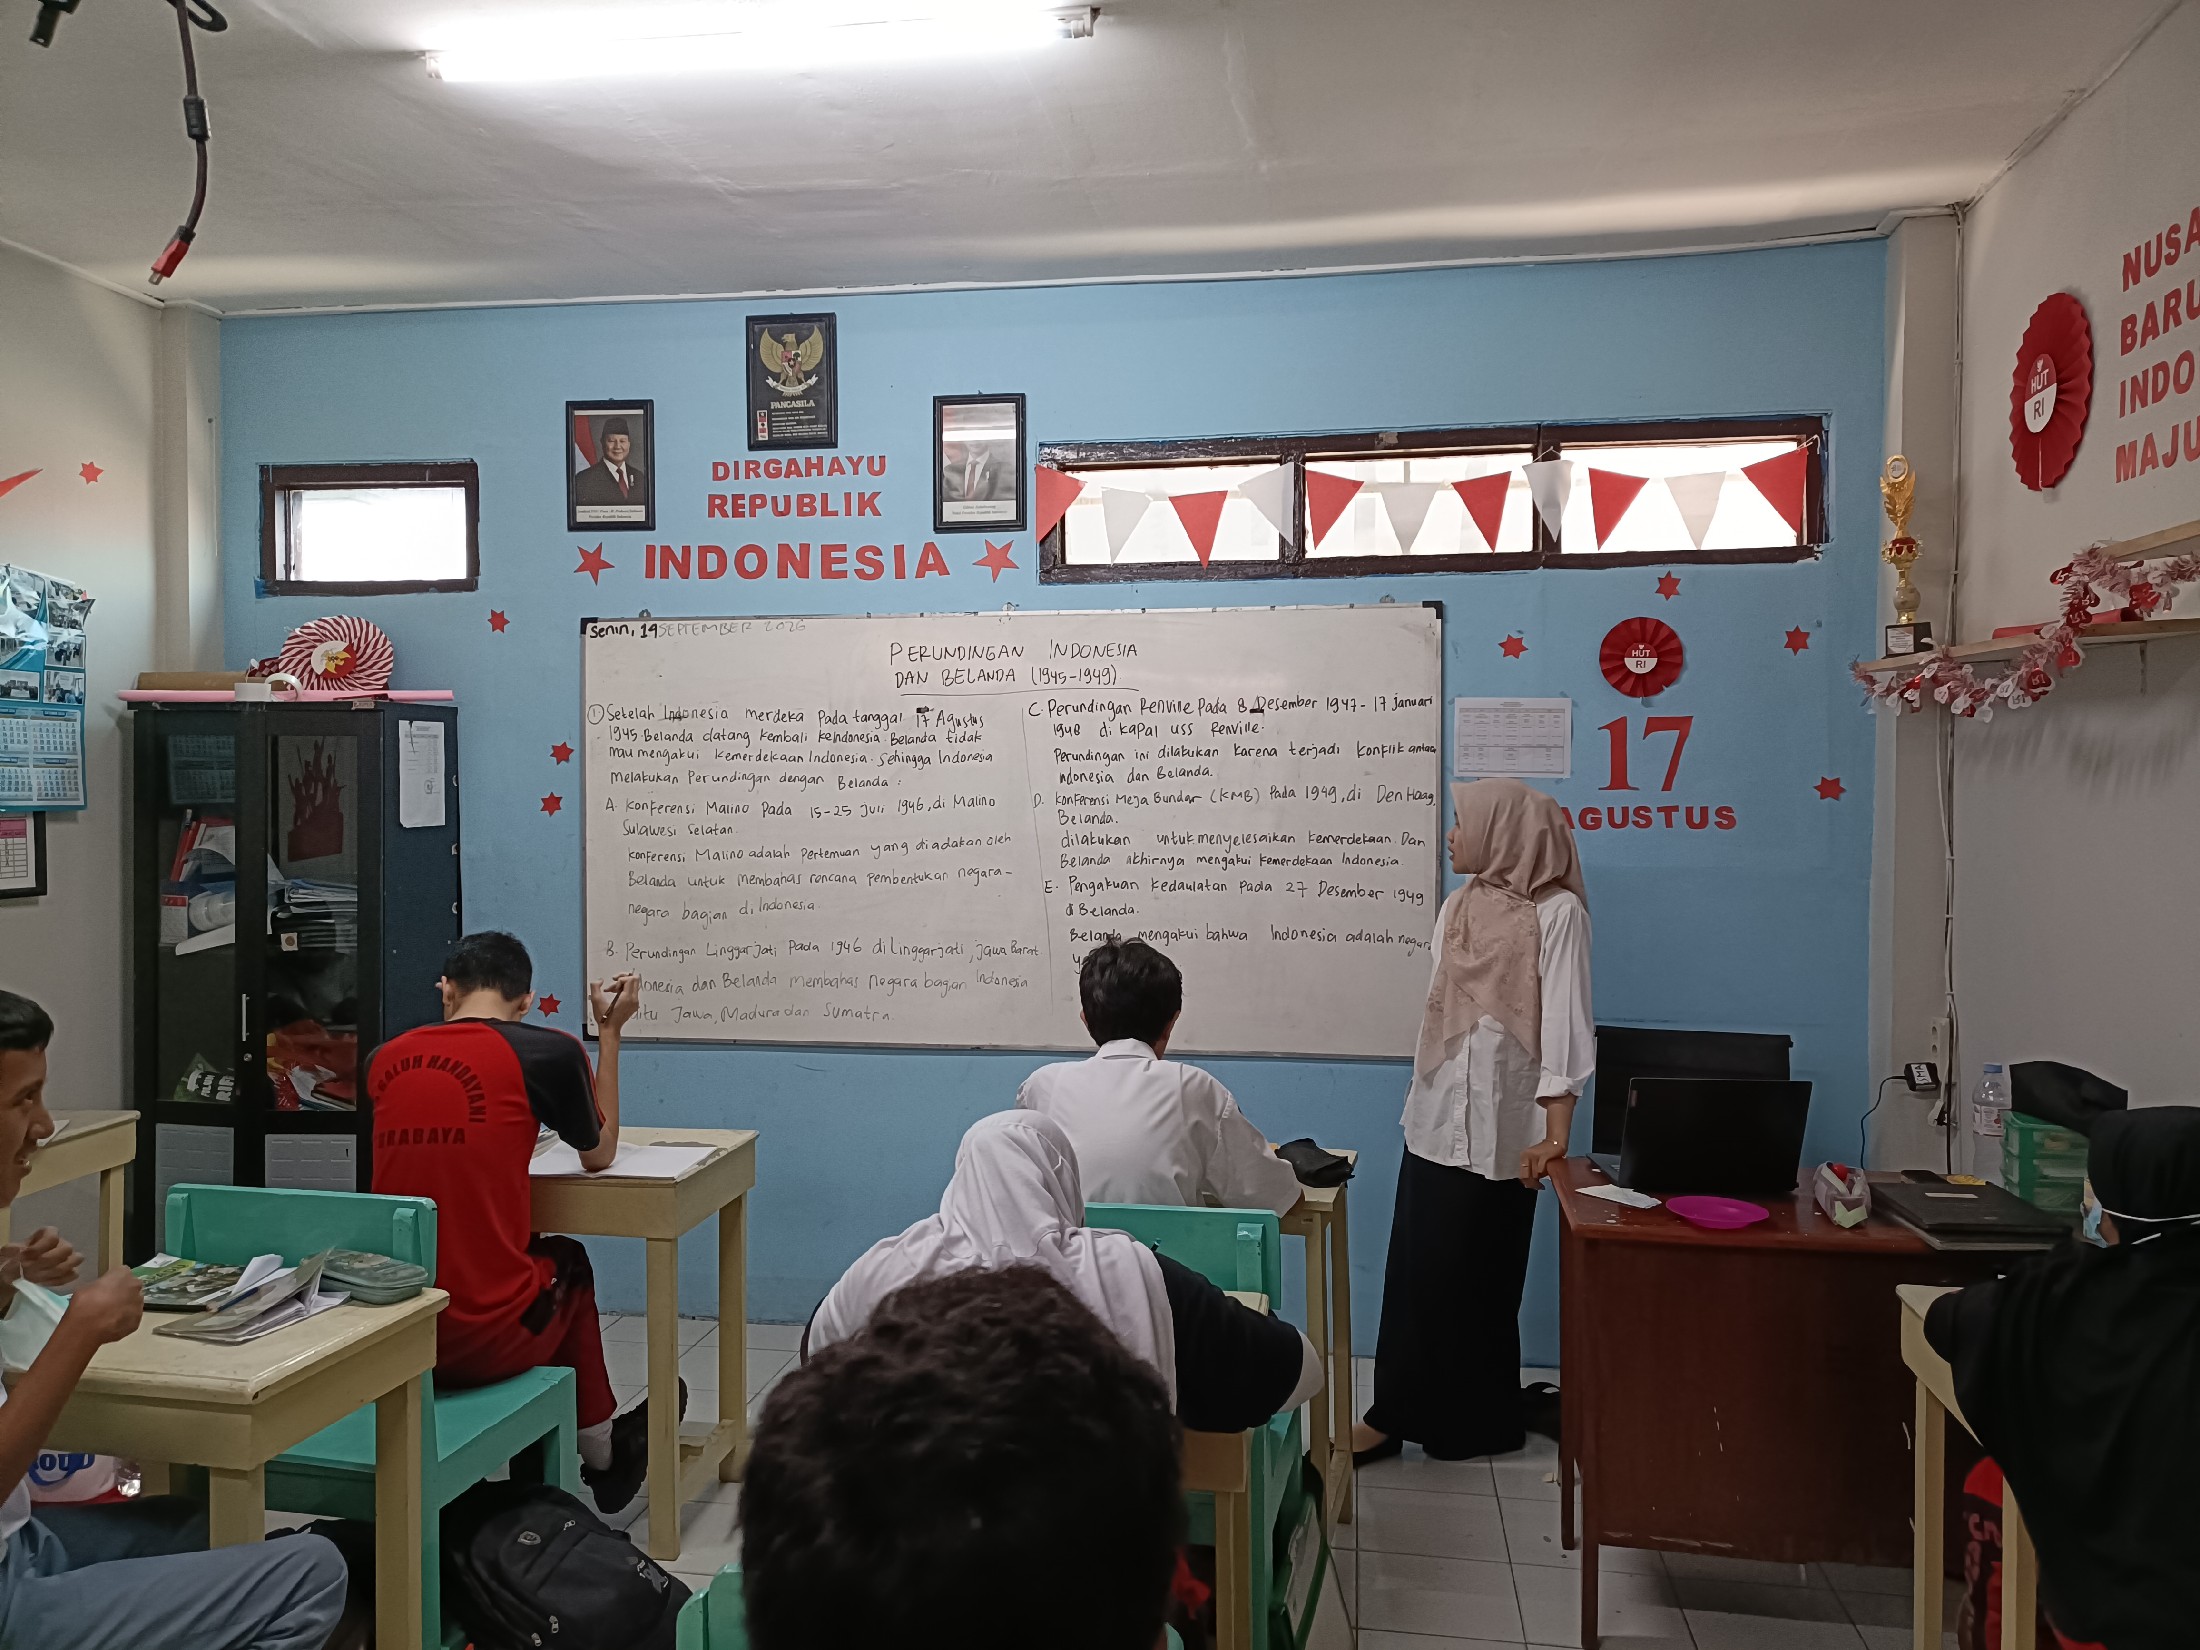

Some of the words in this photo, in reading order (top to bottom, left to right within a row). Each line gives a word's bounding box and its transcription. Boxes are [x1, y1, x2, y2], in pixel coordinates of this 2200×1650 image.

[2031, 368, 2050, 394] HUT
[2119, 349, 2200, 419] INDO
[770, 399, 816, 409] PANCASILA
[2033, 397, 2045, 420] RI
[712, 455, 886, 482] DIRGAHAYU
[707, 491, 883, 518] REPUBLIK
[645, 541, 951, 580] INDONESIA
[890, 642, 1025, 665] PERUNDINGAN
[1049, 639, 1138, 659] INDONESIA
[1632, 649, 1651, 657] HUT
[1635, 660, 1646, 668] RI
[894, 671, 929, 688] DAN
[941, 668, 1016, 687] BELANDA
[606, 703, 655, 722] Setelah
[852, 709, 903, 732] tanggal
[935, 709, 984, 734] Agustus
[1047, 698, 1132, 722] Perundingan
[1374, 695, 1387, 712] 17
[643, 728, 694, 743] Belanda
[702, 727, 751, 749] datang
[890, 731, 937, 747] Belanda
[946, 730, 982, 744] tidak
[1099, 721, 1112, 738] di
[637, 749, 700, 767] mengakui
[1053, 747, 1125, 767] Perundingan
[1134, 749, 1150, 761] ini
[1288, 741, 1340, 759] terjadi
[1598, 715, 1694, 792] 17
[779, 771, 825, 793] dengan
[1127, 767, 1150, 784] dan
[1346, 783, 1361, 802] di
[706, 800, 749, 816] Malino
[932, 794, 946, 809] di
[953, 793, 996, 809] Malino
[622, 819, 677, 837] Sulawesi
[1401, 831, 1426, 847] Dan
[695, 848, 743, 861] Malino
[748, 844, 790, 859] adalah
[870, 841, 909, 860] yang
[986, 832, 1011, 846] oleh
[1060, 853, 1111, 868] Belanda
[1196, 855, 1251, 872] mengakui
[687, 875, 725, 889] untuk
[1068, 875, 1140, 897] Pengakuan
[1285, 881, 1308, 898] 27
[1318, 880, 1384, 900] Desember
[628, 903, 670, 927] negara
[682, 901, 728, 930] bagian
[739, 900, 754, 915] di
[1206, 922, 1248, 941] bahwa
[1270, 923, 1337, 943] Indonesia
[1345, 929, 1393, 944] adalah
[625, 941, 696, 964] Perundingan
[831, 936, 863, 956] 1946
[692, 977, 717, 993] dan
[722, 970, 777, 990] Belanda
[924, 971, 967, 999] bagian
[976, 969, 1028, 988] Indonesia
[784, 1004, 810, 1017] dan
[378, 1127, 466, 1149] URABAYA
